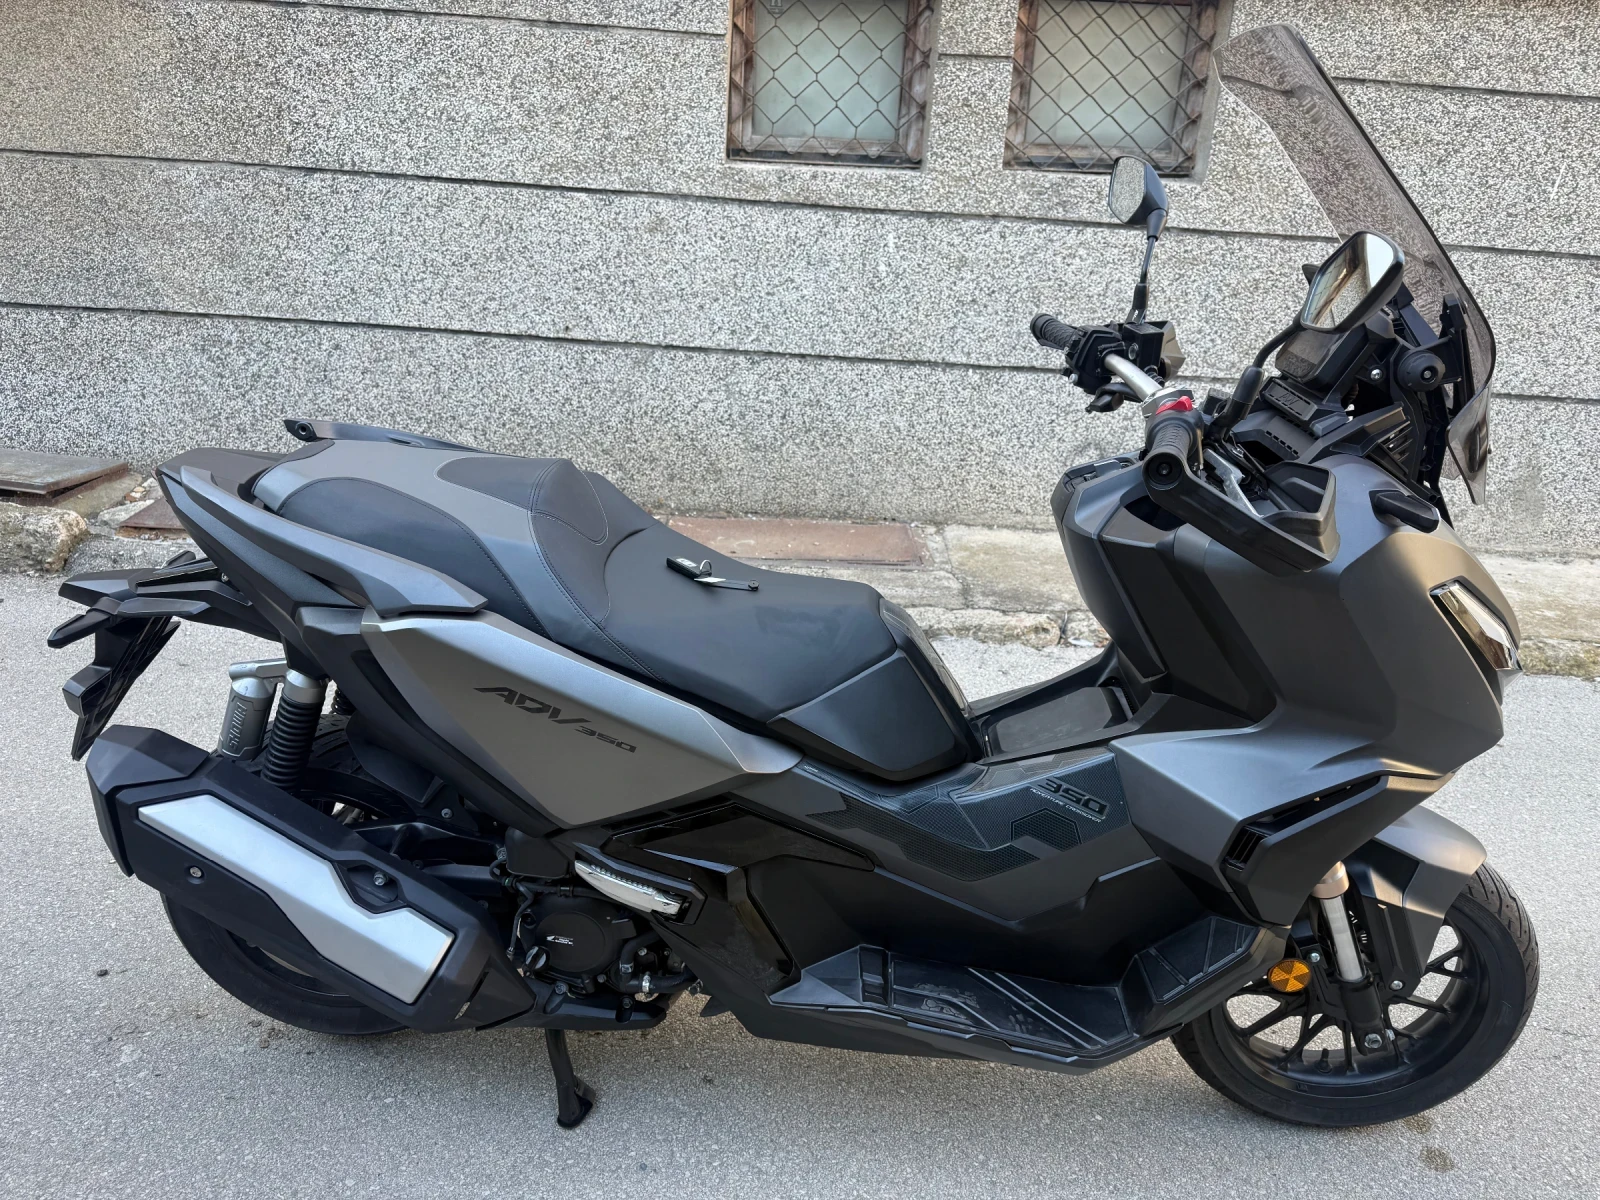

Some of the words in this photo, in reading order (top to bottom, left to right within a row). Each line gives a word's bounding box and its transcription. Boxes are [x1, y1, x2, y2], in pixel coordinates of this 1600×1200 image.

[228, 701, 248, 750] SHOWA
[473, 686, 592, 724] ADV
[574, 725, 637, 753] 350
[1037, 777, 1108, 816] 350
